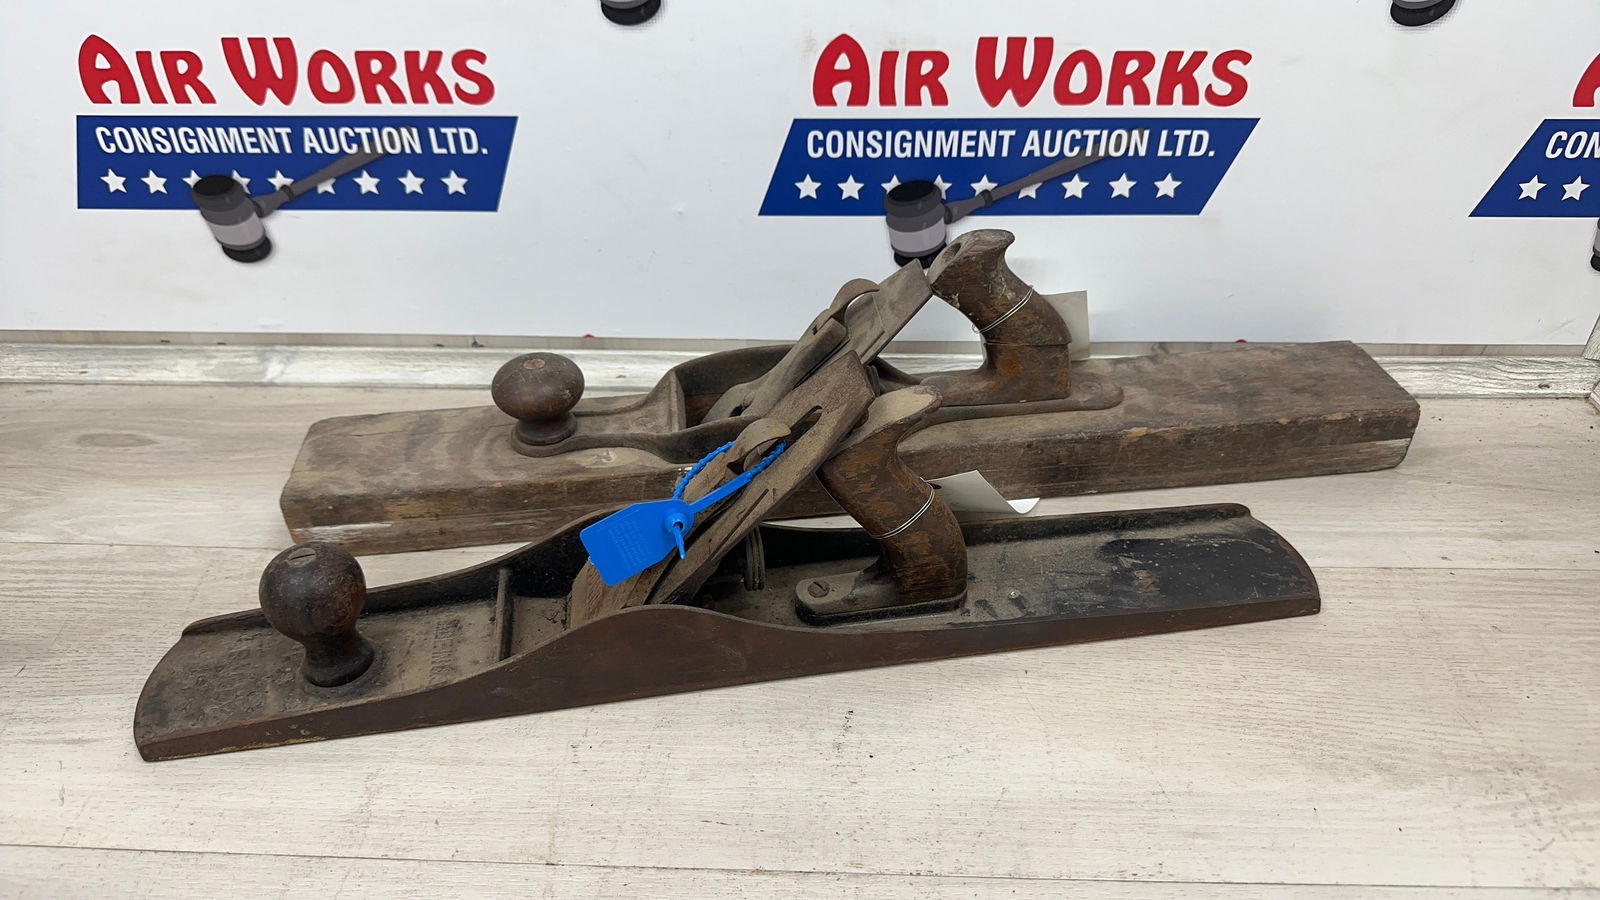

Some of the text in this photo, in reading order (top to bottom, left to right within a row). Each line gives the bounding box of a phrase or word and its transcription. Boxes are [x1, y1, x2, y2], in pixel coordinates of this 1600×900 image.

[78, 34, 495, 106] AIR WORKS
[812, 33, 1252, 108] AIR WORKS
[95, 126, 488, 154] CONSIGNMENT AUCTION LTD.
[807, 129, 1216, 158] CONSIGNMENT AUCTION LTD.
